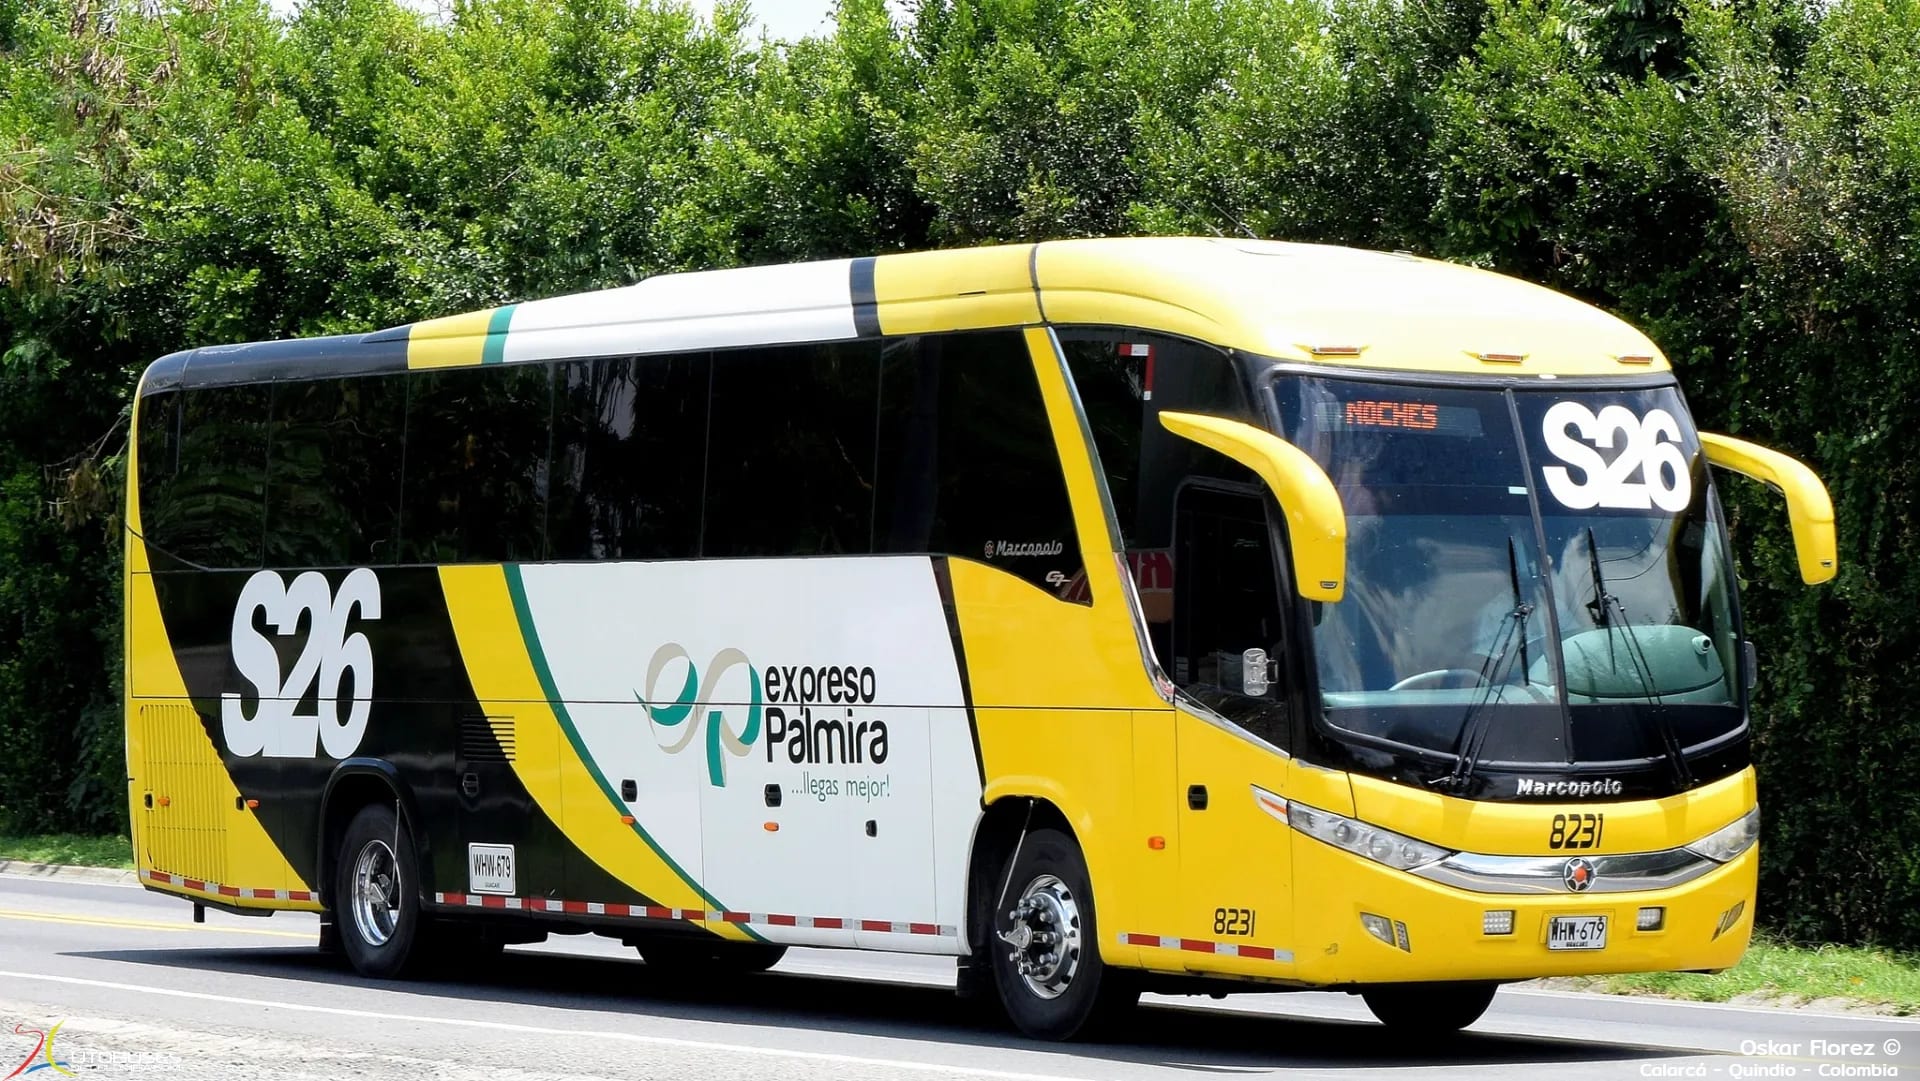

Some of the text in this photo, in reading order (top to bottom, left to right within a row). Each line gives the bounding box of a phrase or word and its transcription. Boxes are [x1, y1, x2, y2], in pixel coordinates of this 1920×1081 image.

[1345, 400, 1439, 430] NOCHES
[1542, 401, 1692, 512] S26
[996, 540, 1063, 557] Marcopolo
[221, 567, 382, 760] S26
[764, 665, 877, 715] expreso
[764, 707, 889, 765] Palmira
[845, 773, 891, 804] mejor!
[1516, 778, 1623, 797] Marcopolo
[1549, 813, 1603, 850] 8231
[473, 854, 511, 878] WHW-679
[1213, 907, 1256, 938] 8231
[1551, 920, 1605, 941] WHW-679
